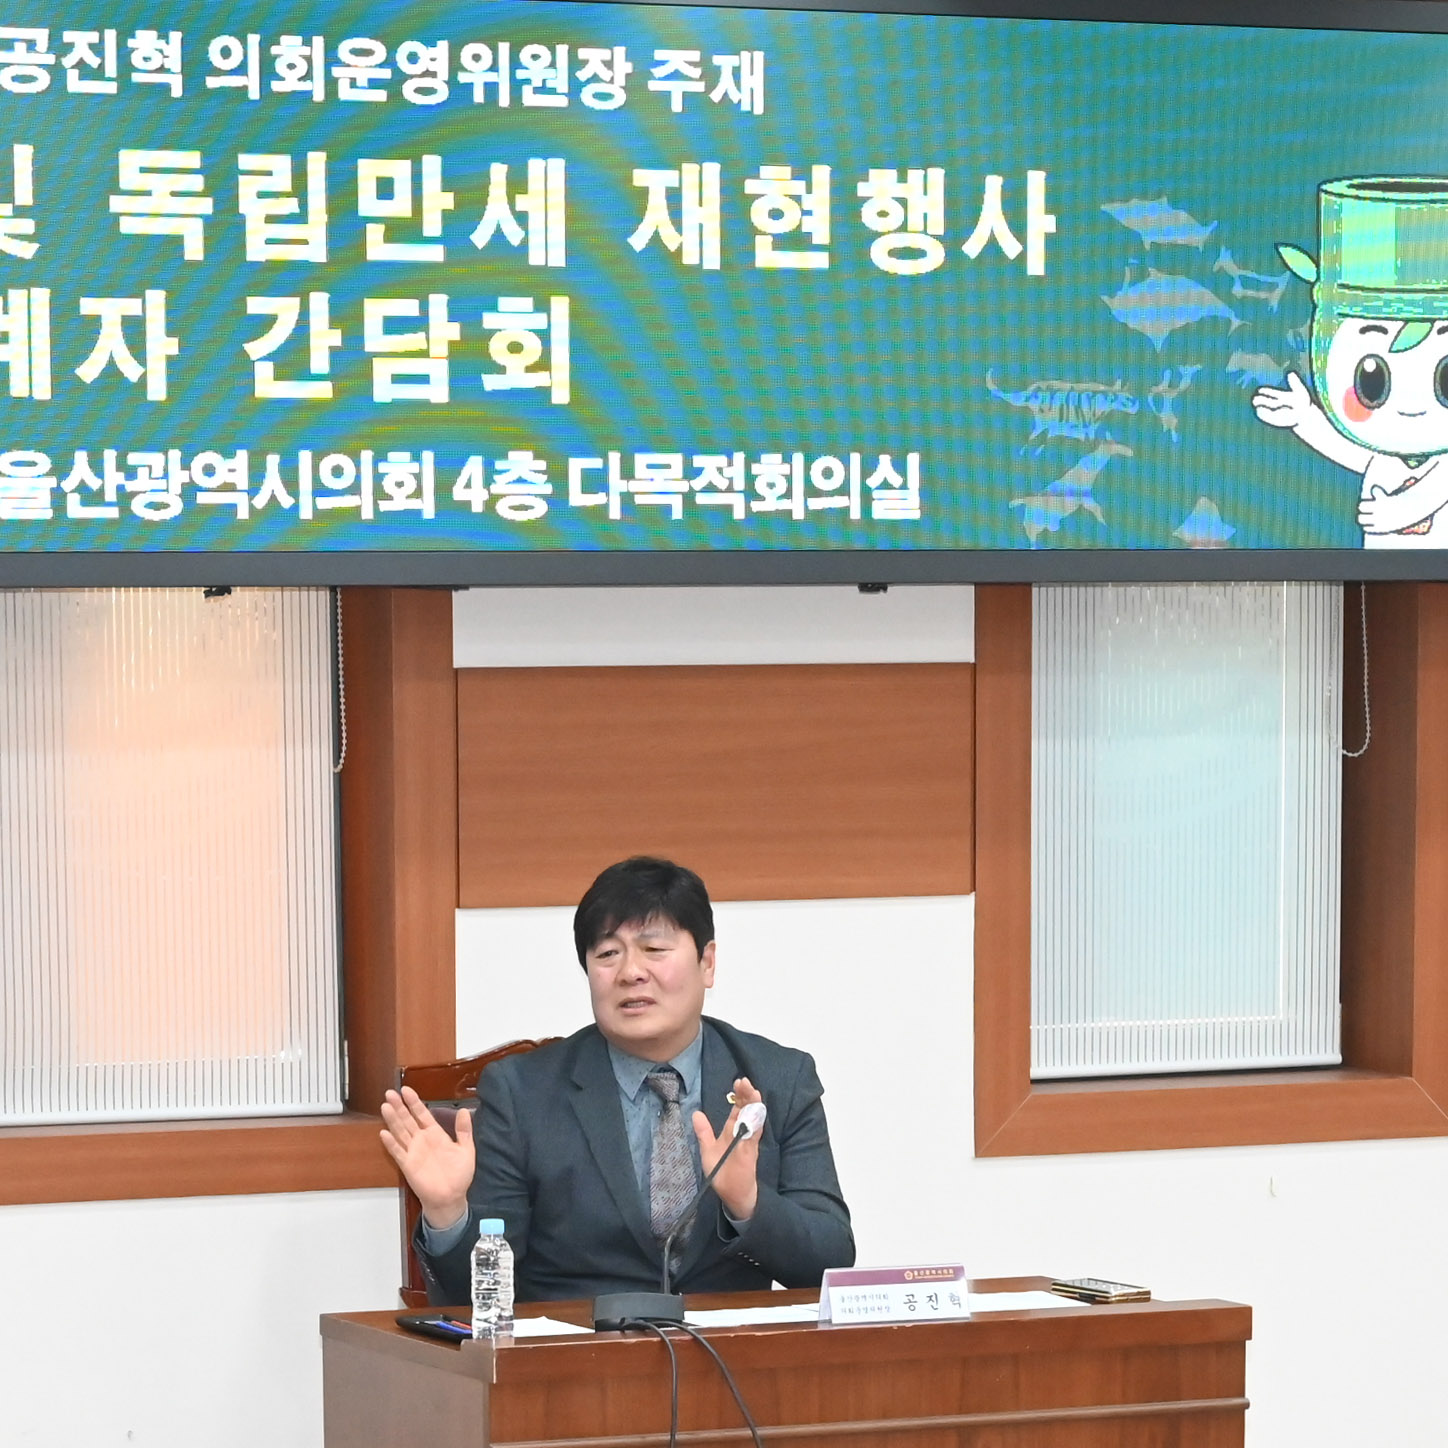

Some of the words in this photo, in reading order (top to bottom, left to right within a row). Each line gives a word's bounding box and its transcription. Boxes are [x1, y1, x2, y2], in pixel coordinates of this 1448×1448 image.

[205, 33, 633, 110] 의회운영위원장
[647, 49, 765, 115] 주재
[109, 149, 566, 267] 독립만세
[628, 160, 1057, 276] 재현행사
[243, 291, 570, 405] 간담회
[452, 450, 553, 522] 4층
[568, 451, 921, 520] 다목적회의실
